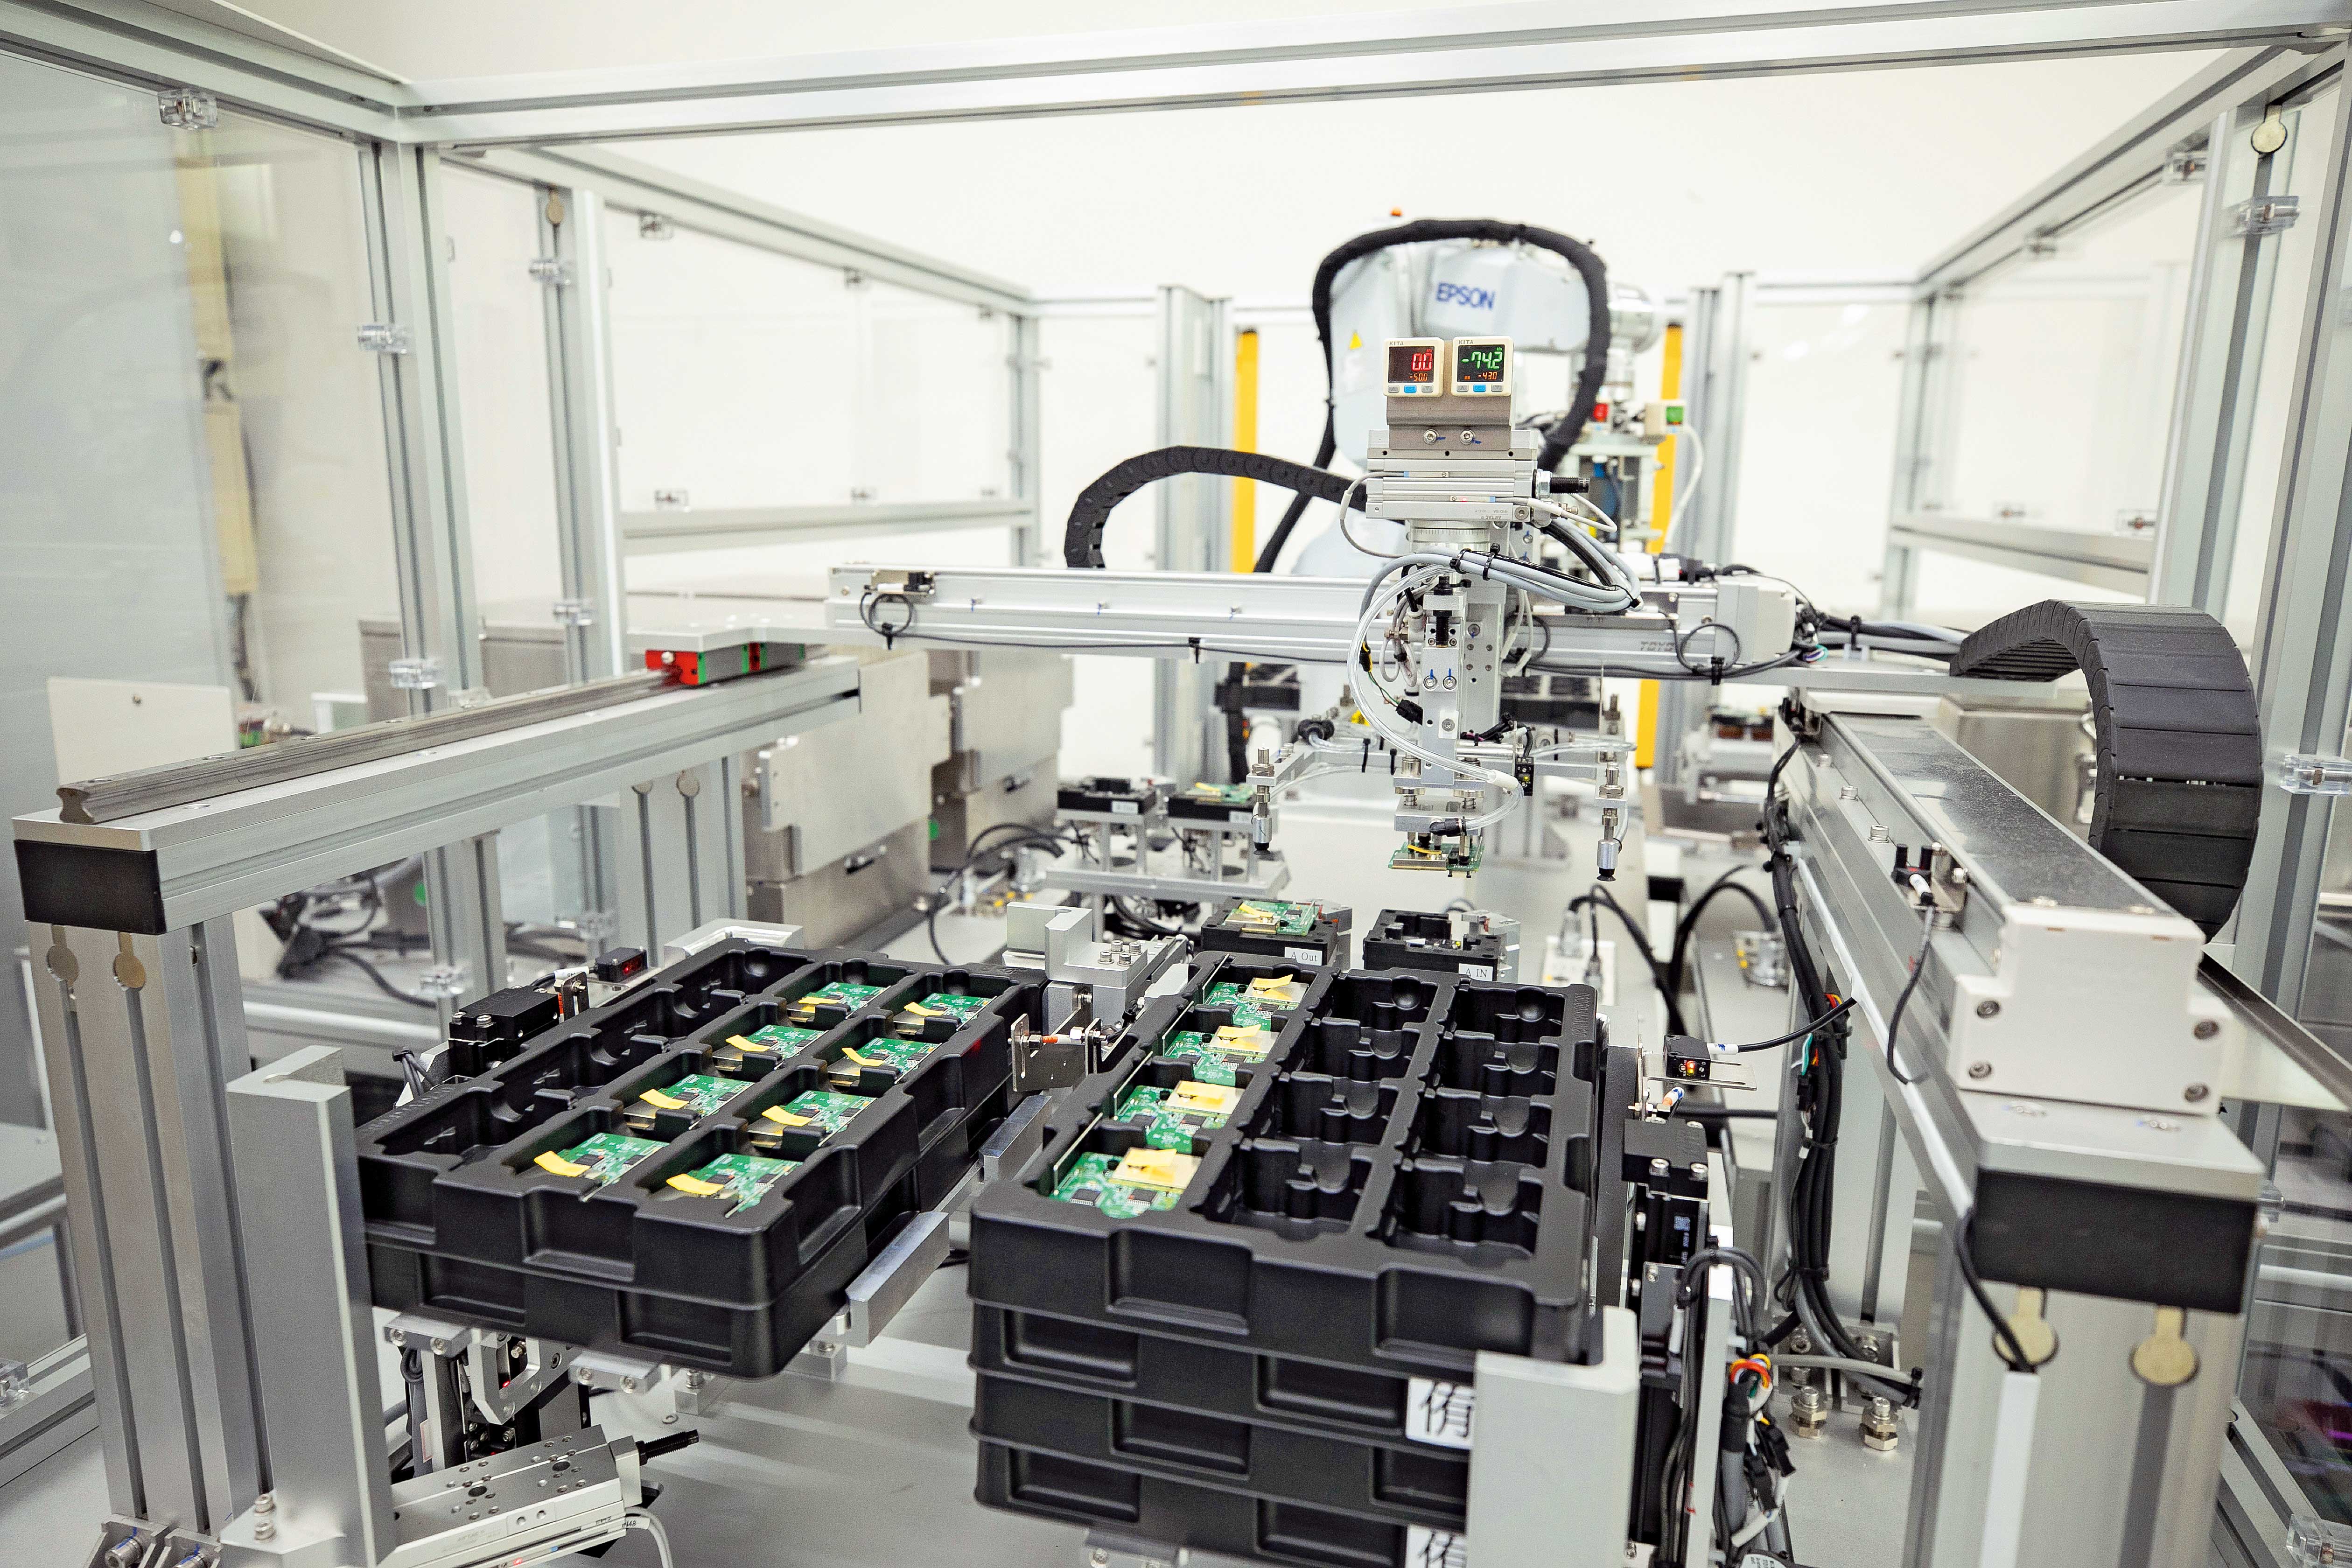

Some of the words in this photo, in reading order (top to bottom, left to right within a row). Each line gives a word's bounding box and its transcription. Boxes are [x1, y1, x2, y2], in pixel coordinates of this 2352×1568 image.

[1437, 282, 1495, 310] EPSON
[1461, 351, 1503, 369] -74.2
[1302, 952, 1318, 961] Out
[1466, 968, 1471, 976] A
[1476, 968, 1487, 978] IN
